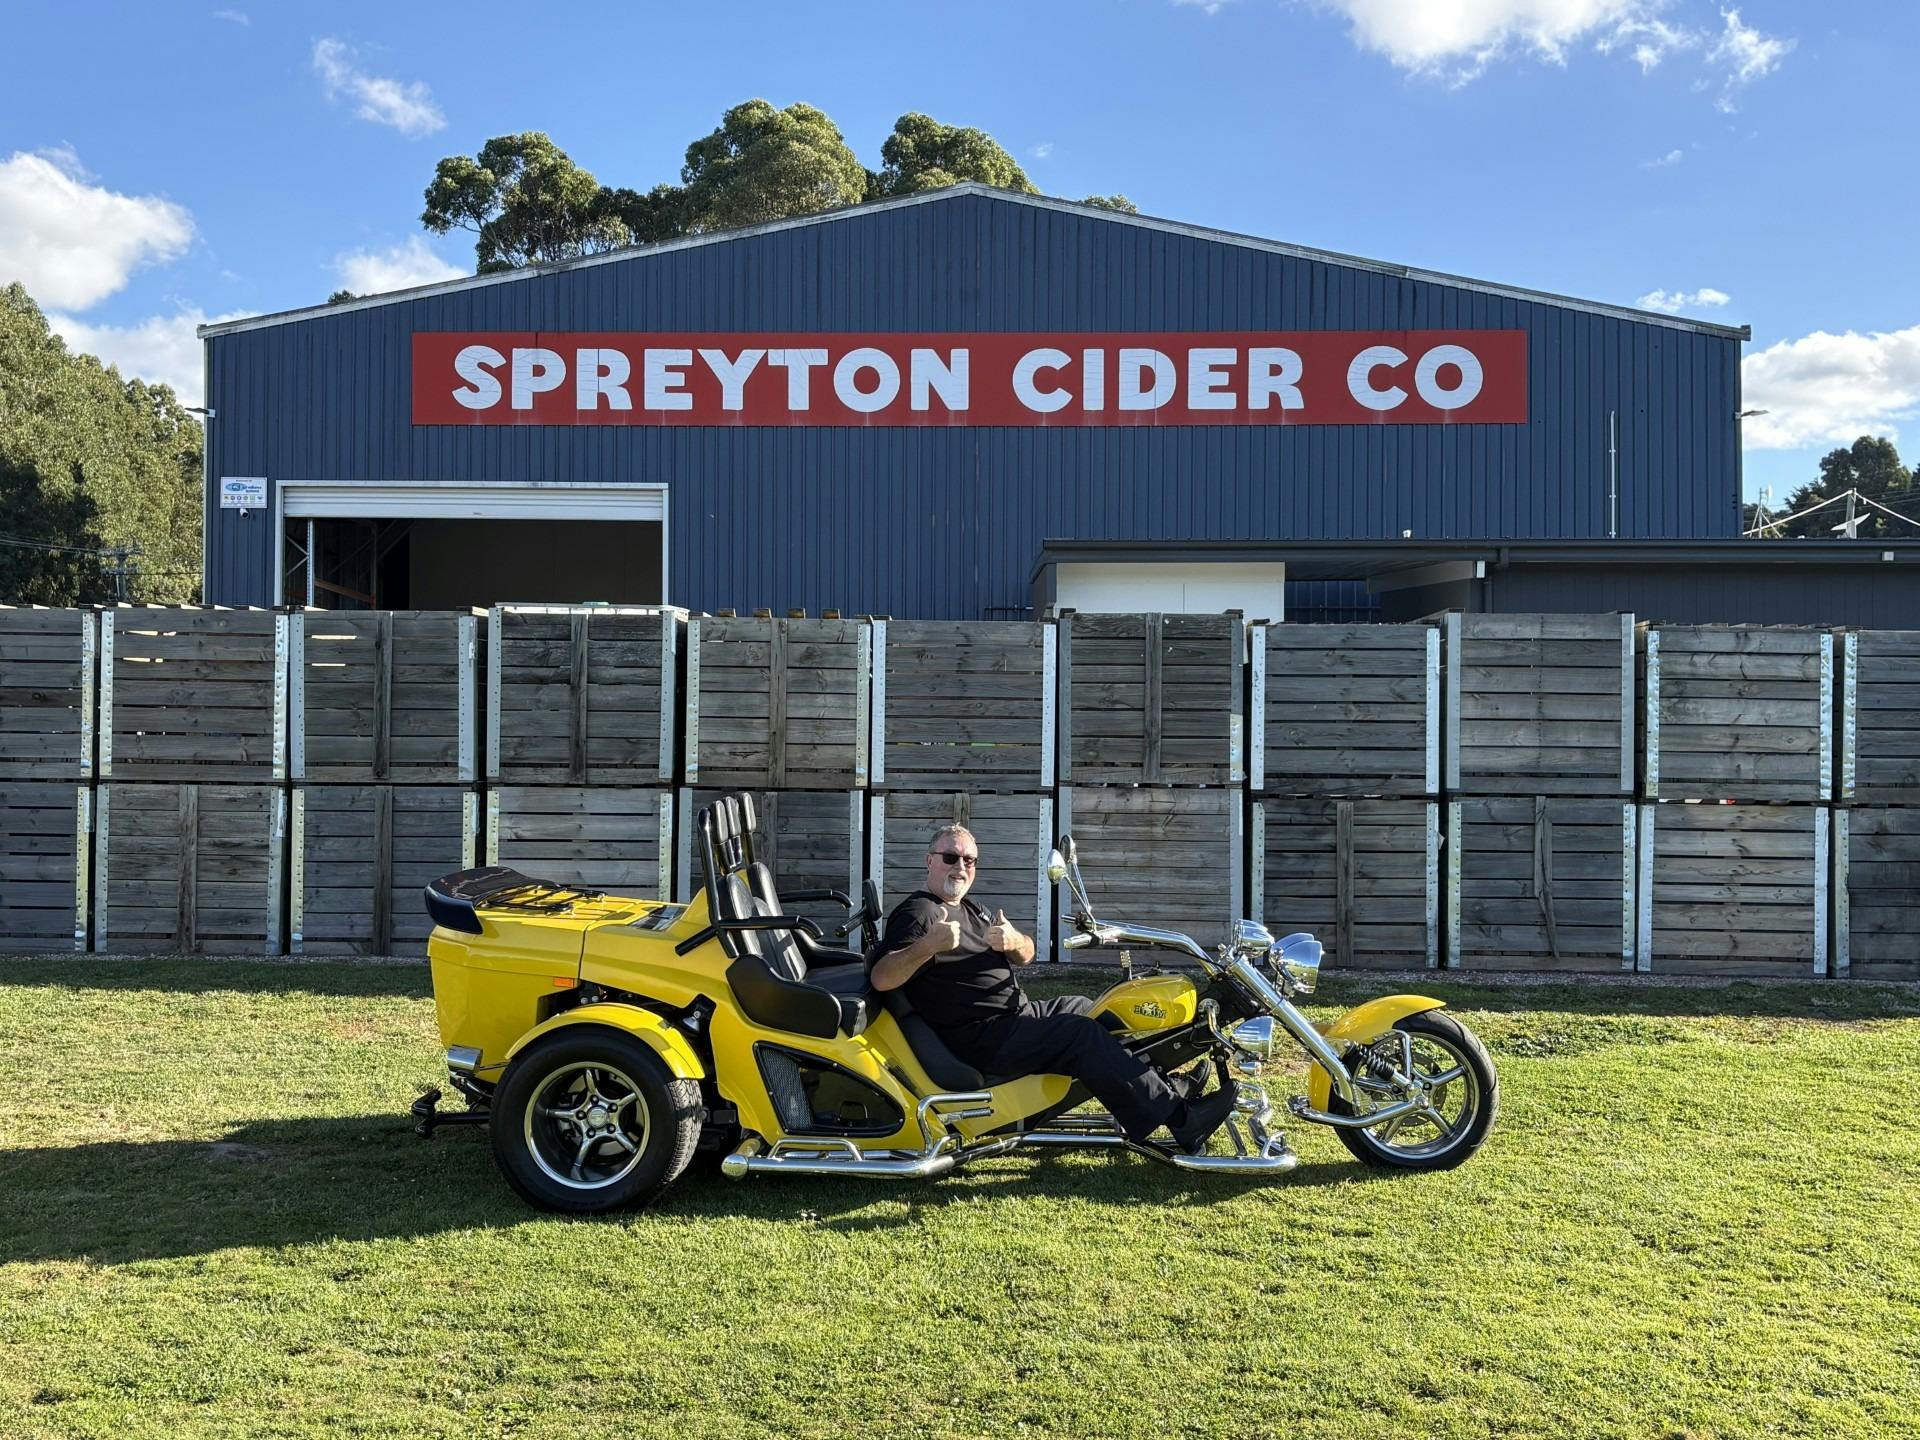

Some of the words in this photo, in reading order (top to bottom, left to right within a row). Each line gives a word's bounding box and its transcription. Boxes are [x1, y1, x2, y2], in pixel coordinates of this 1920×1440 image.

[452, 345, 970, 412] SPREYTON
[1012, 348, 1305, 412] CIDER
[1346, 345, 1484, 411] CO
